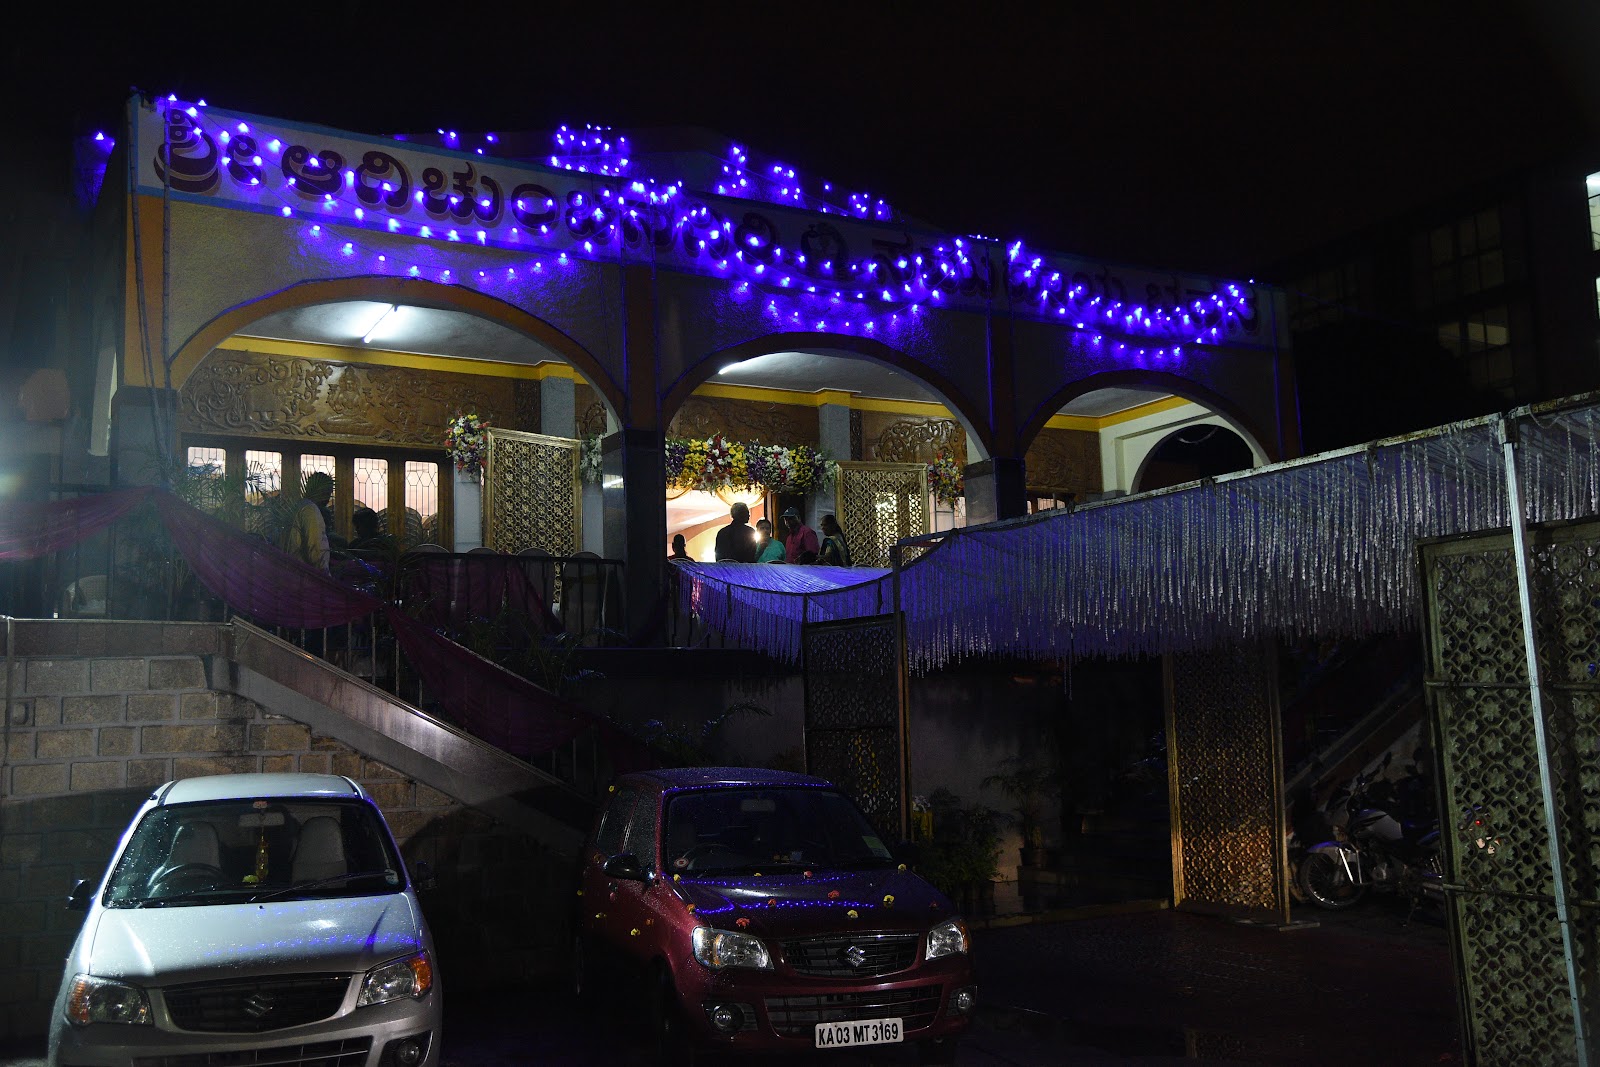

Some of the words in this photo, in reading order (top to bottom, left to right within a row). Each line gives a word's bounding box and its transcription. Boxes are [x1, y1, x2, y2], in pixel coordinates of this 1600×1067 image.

[153, 107, 265, 197] ಶ್ರೀ
[818, 1027, 835, 1046] KA
[836, 1026, 850, 1044] 03
[853, 1025, 871, 1043] MT
[872, 1022, 899, 1041] 3169
